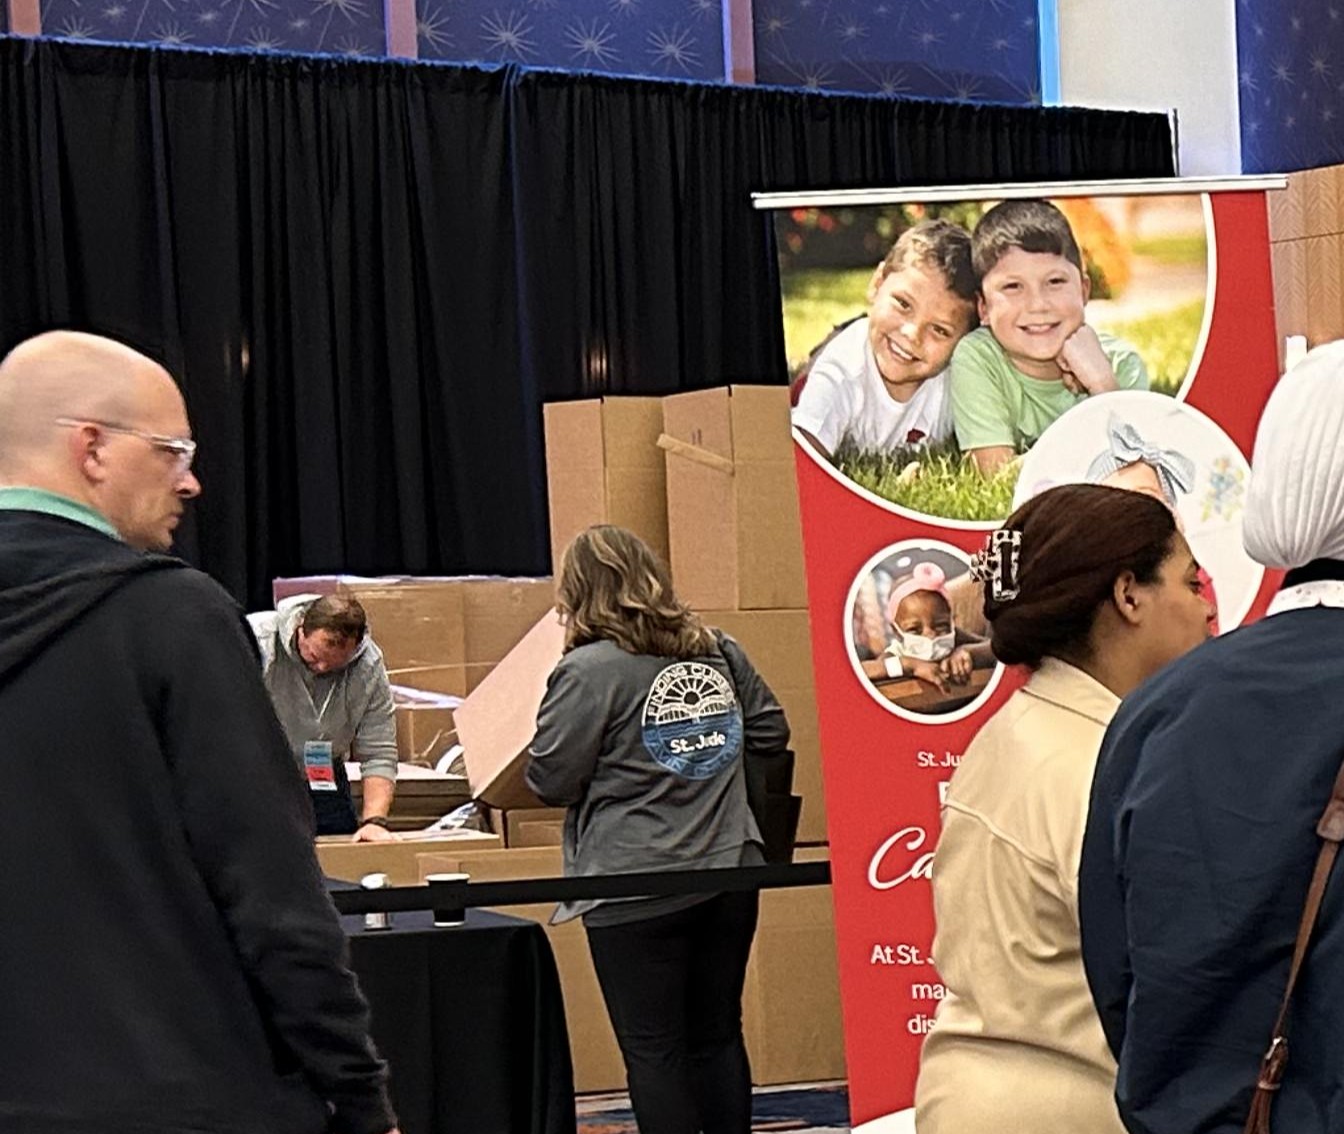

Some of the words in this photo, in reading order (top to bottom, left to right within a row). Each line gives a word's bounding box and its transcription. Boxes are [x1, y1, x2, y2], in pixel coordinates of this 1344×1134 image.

[695, 731, 726, 749] Jude
[940, 751, 961, 767] Ju
[868, 826, 936, 890] Ca
[870, 943, 894, 965] At
[911, 983, 945, 1000] ma
[907, 1013, 936, 1034] dis
